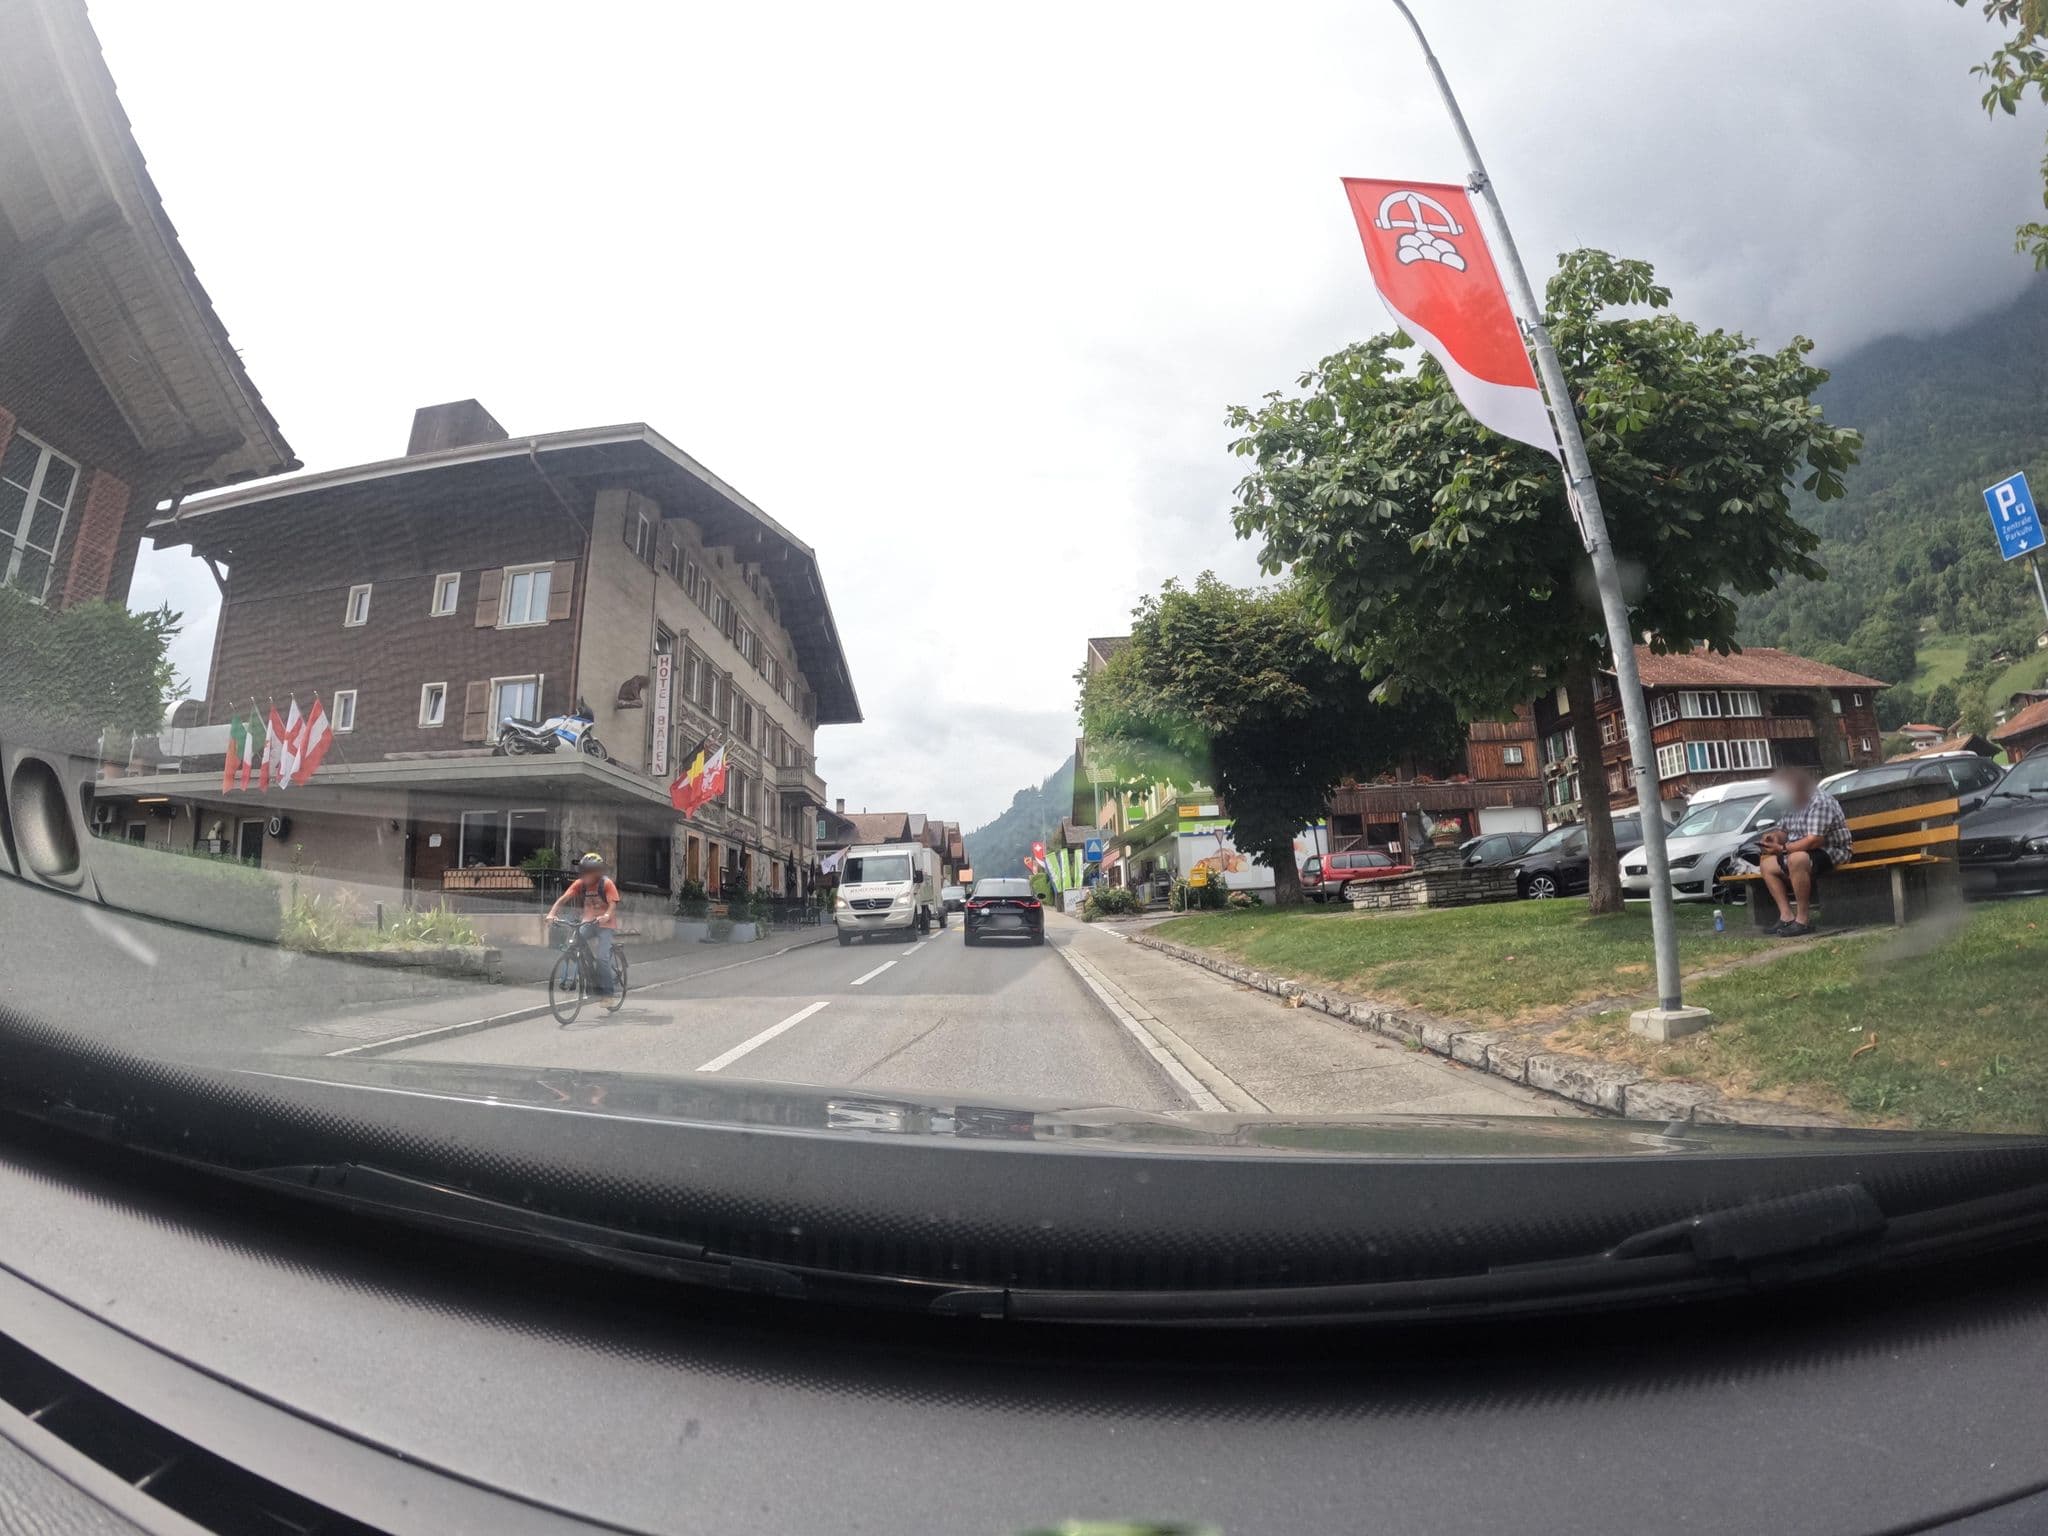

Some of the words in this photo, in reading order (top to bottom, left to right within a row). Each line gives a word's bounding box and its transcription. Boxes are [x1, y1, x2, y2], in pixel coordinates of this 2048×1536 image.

[1995, 483, 2017, 522] P
[658, 657, 669, 710] HOTEL
[655, 715, 666, 772] BÄREN
